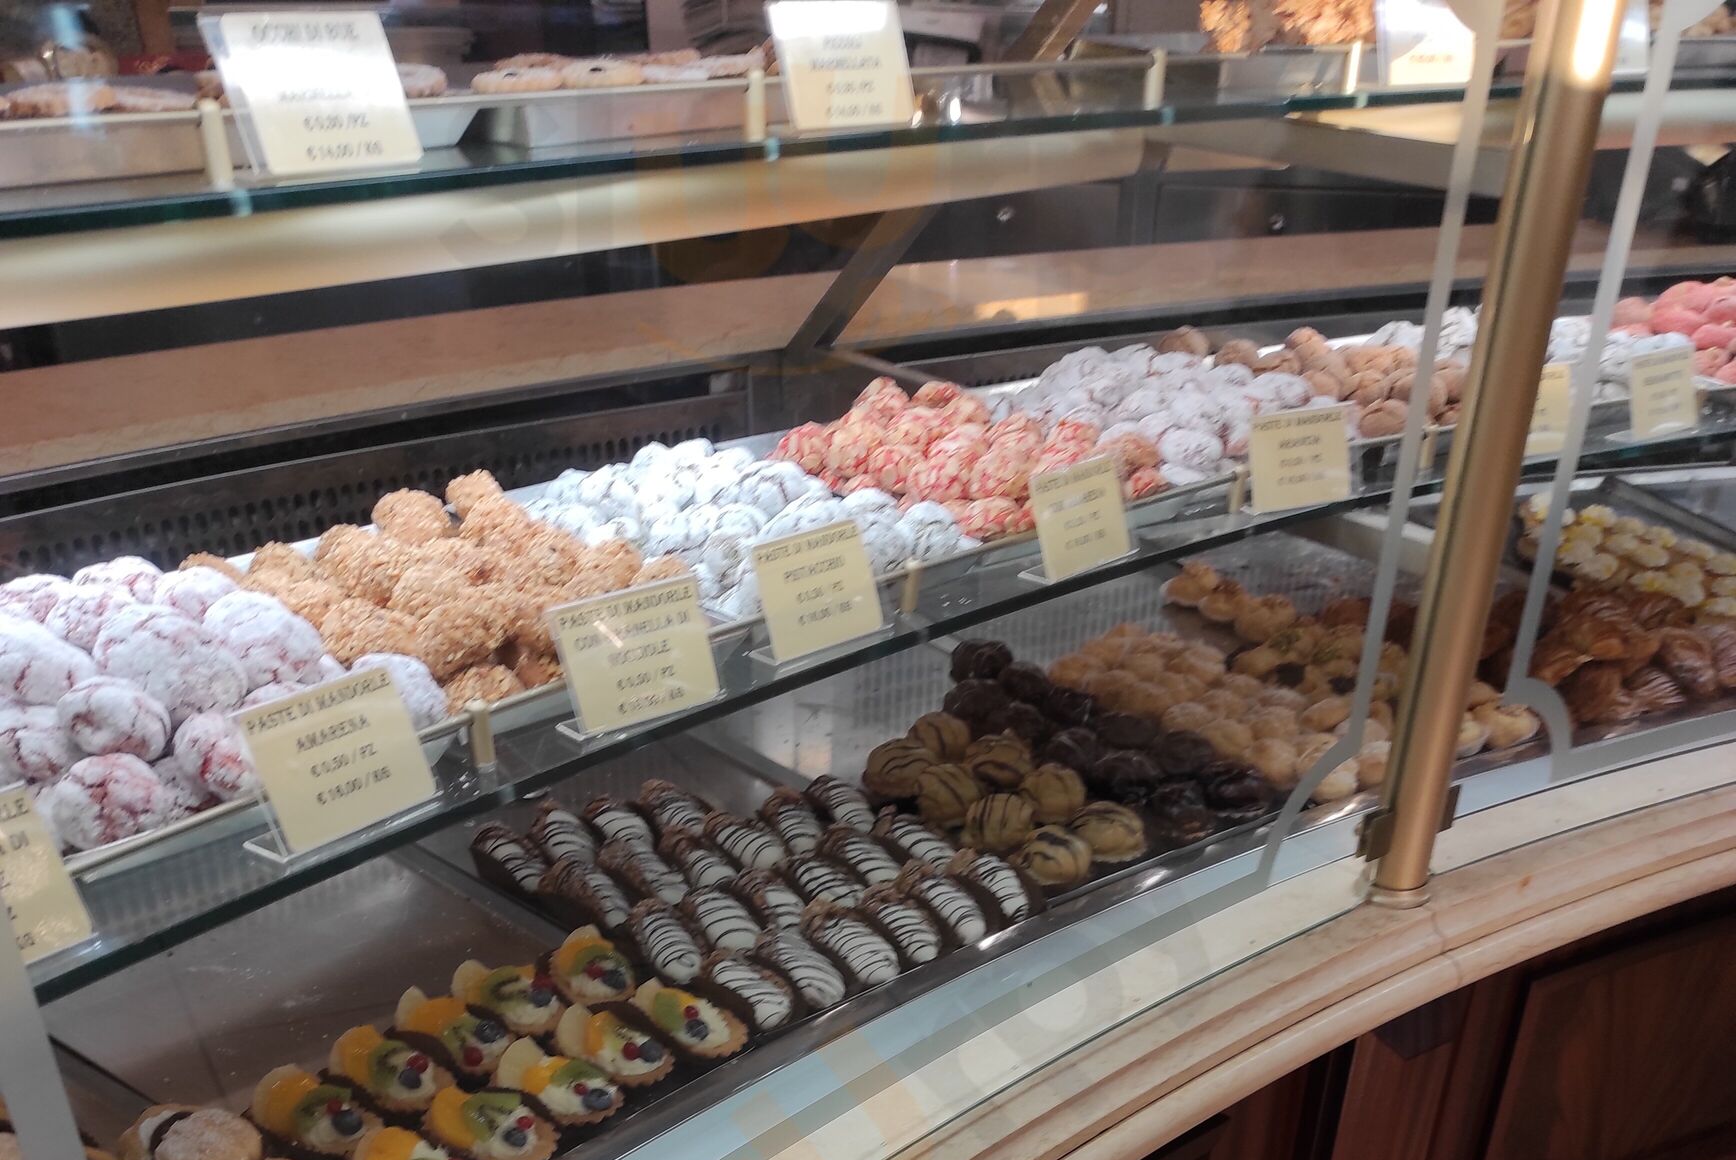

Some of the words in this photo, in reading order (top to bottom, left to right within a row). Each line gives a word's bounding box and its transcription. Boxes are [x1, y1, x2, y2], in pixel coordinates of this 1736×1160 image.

[623, 586, 692, 615] MANDORLE
[246, 706, 297, 736] PASTE
[298, 702, 314, 718] DI
[317, 672, 391, 711] MANDORLE
[295, 714, 369, 752] AMARENA
